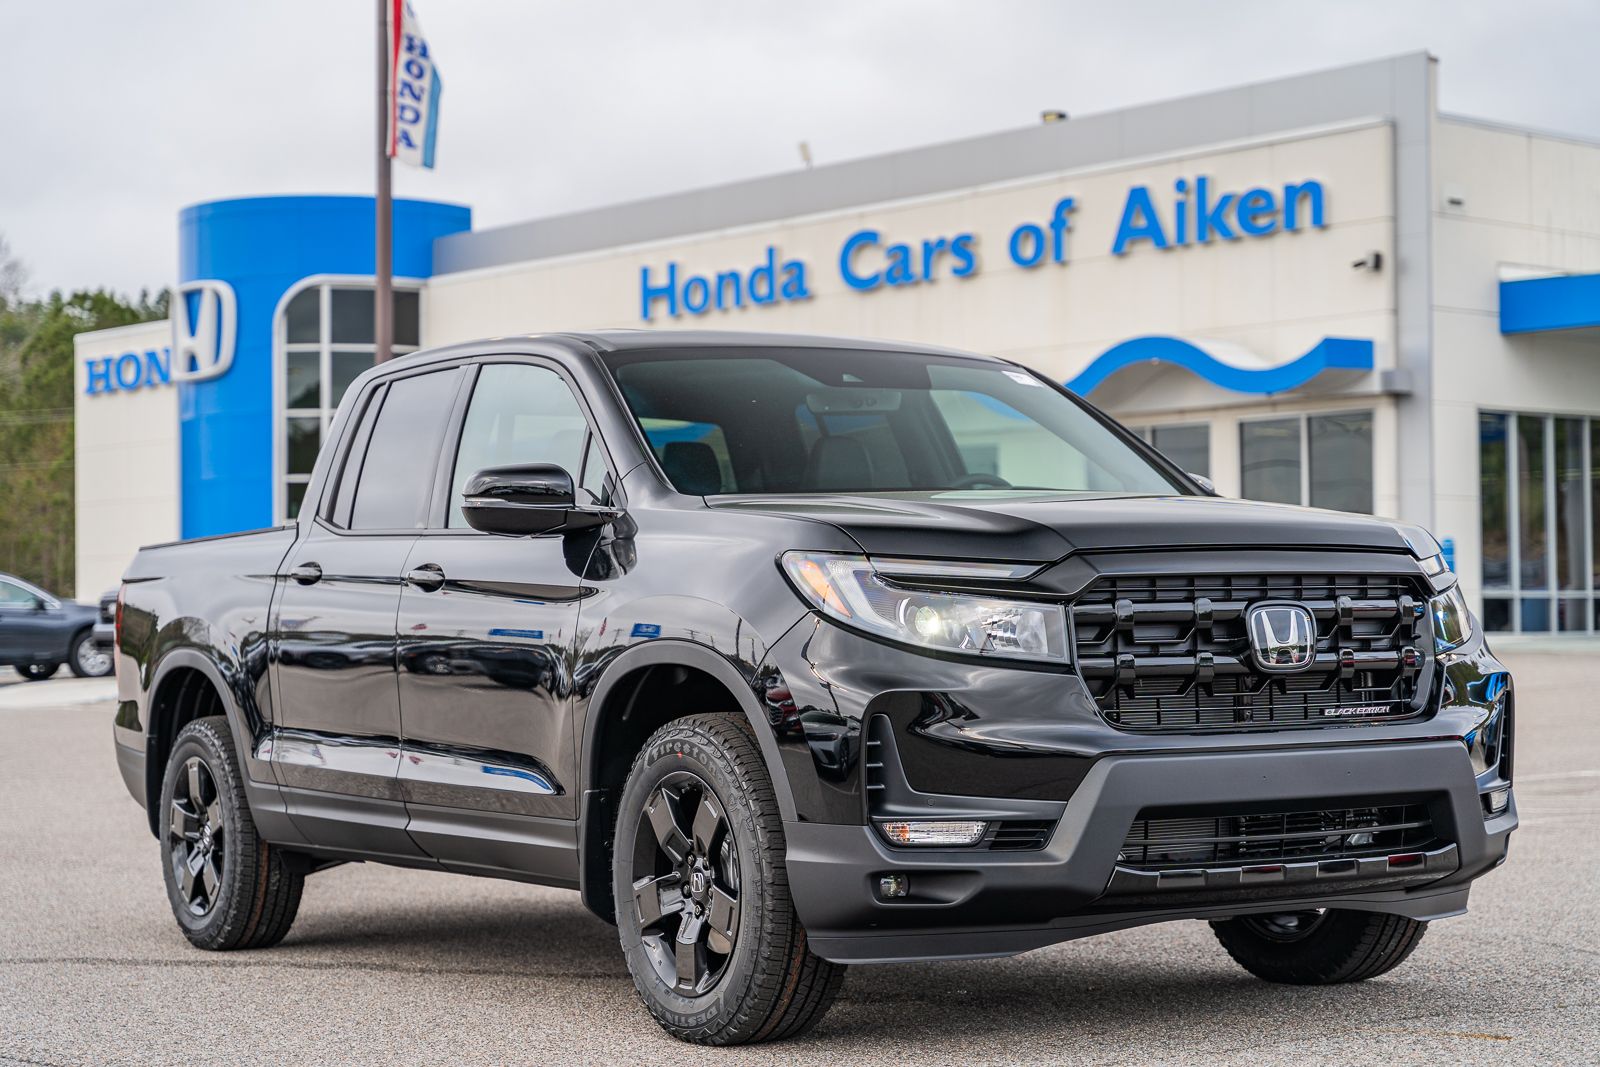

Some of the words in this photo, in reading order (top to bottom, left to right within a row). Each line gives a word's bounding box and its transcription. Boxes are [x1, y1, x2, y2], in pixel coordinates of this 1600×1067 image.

[640, 245, 812, 321] Honda
[840, 231, 977, 292] Cars
[1009, 199, 1076, 268] of
[1112, 176, 1327, 256] Aiken
[85, 348, 172, 396] HON
[1324, 707, 1357, 716] BLACK
